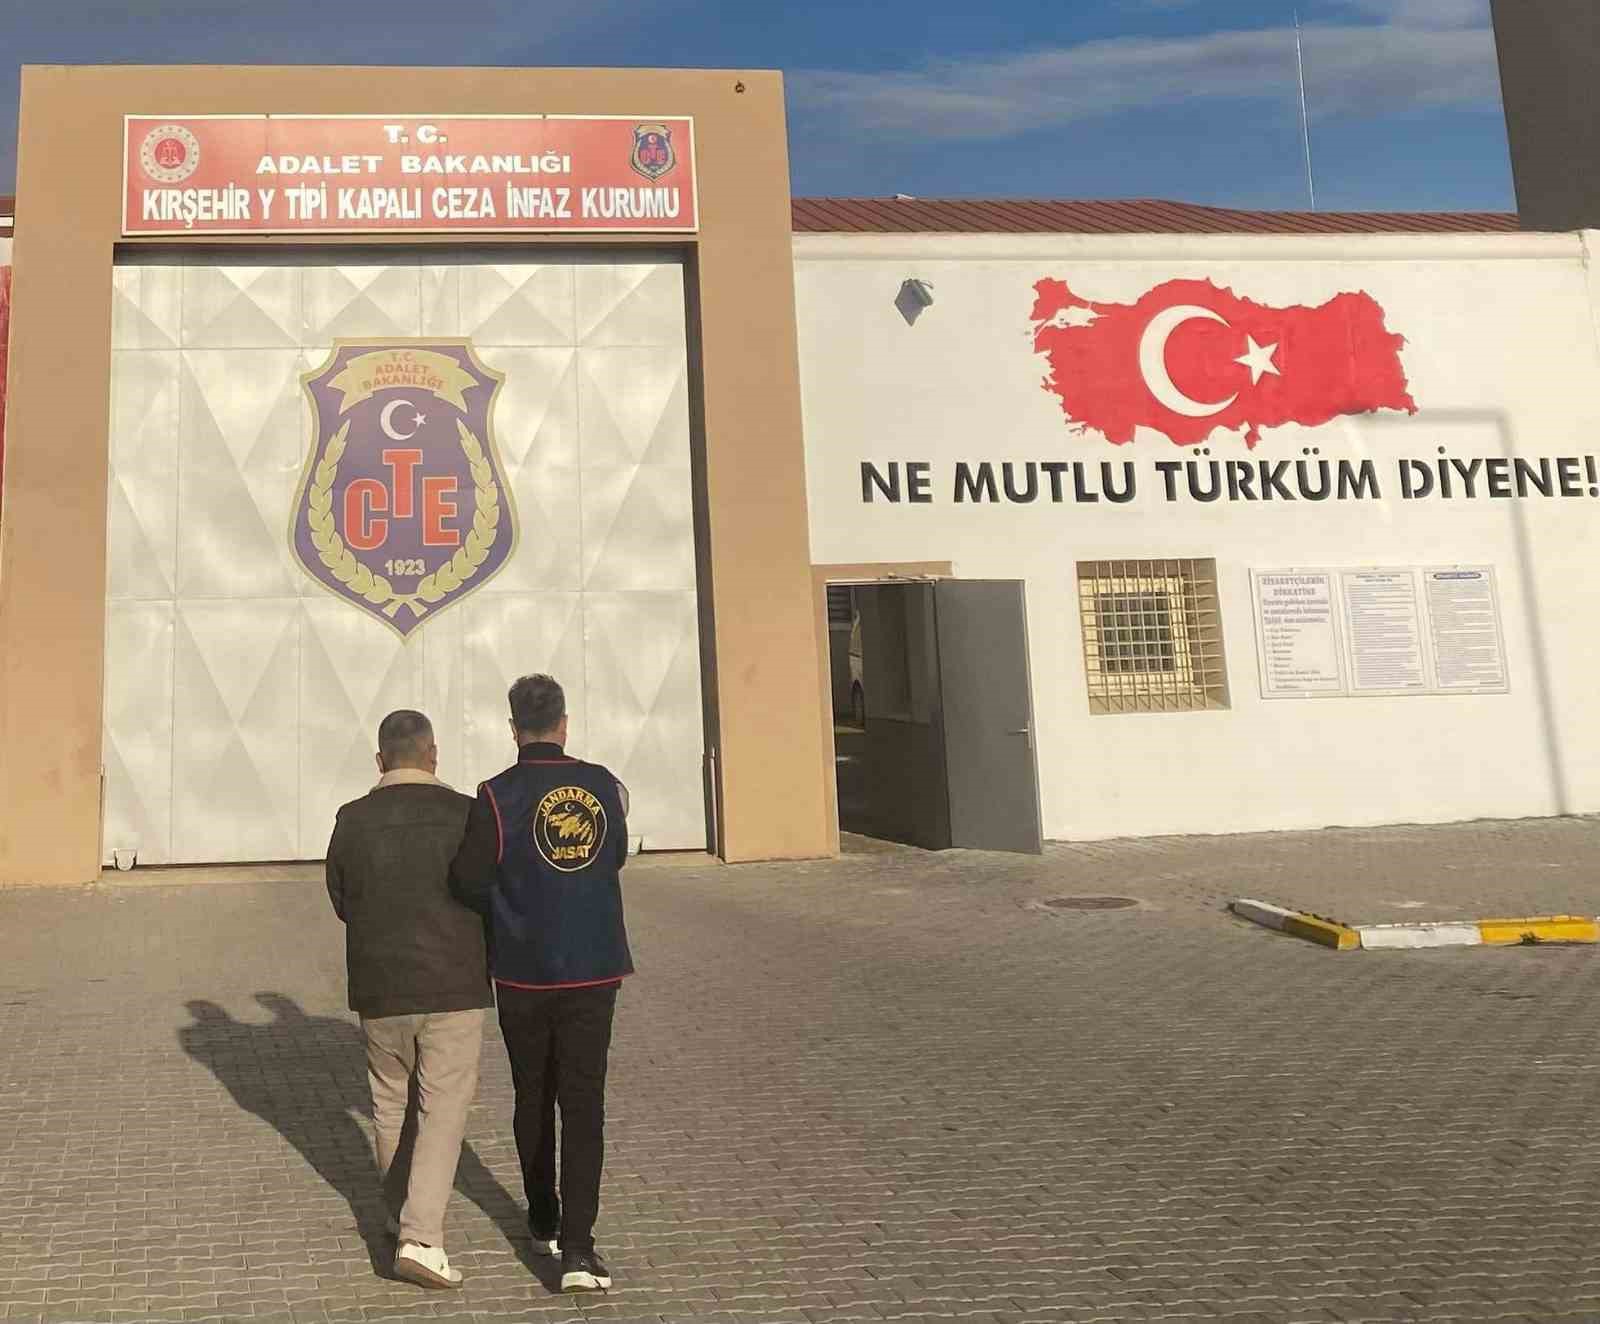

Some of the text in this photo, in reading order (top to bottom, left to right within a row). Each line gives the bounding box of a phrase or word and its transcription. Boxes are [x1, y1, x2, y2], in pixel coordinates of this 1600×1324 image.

[256, 151, 571, 174] ADALET BAKANLIĞI
[143, 181, 681, 228] KIRŞEHİR Y TİPİ KAPALI CEZA İNFAZ KURUMU
[375, 363, 430, 375] ADALET
[860, 445, 1600, 504] NE MUTLU TÜRKÜM DİYENE!
[343, 448, 461, 551] CTE
[384, 558, 426, 576] 1923
[540, 788, 602, 817] JANDARMA
[551, 844, 592, 860] JASAT
